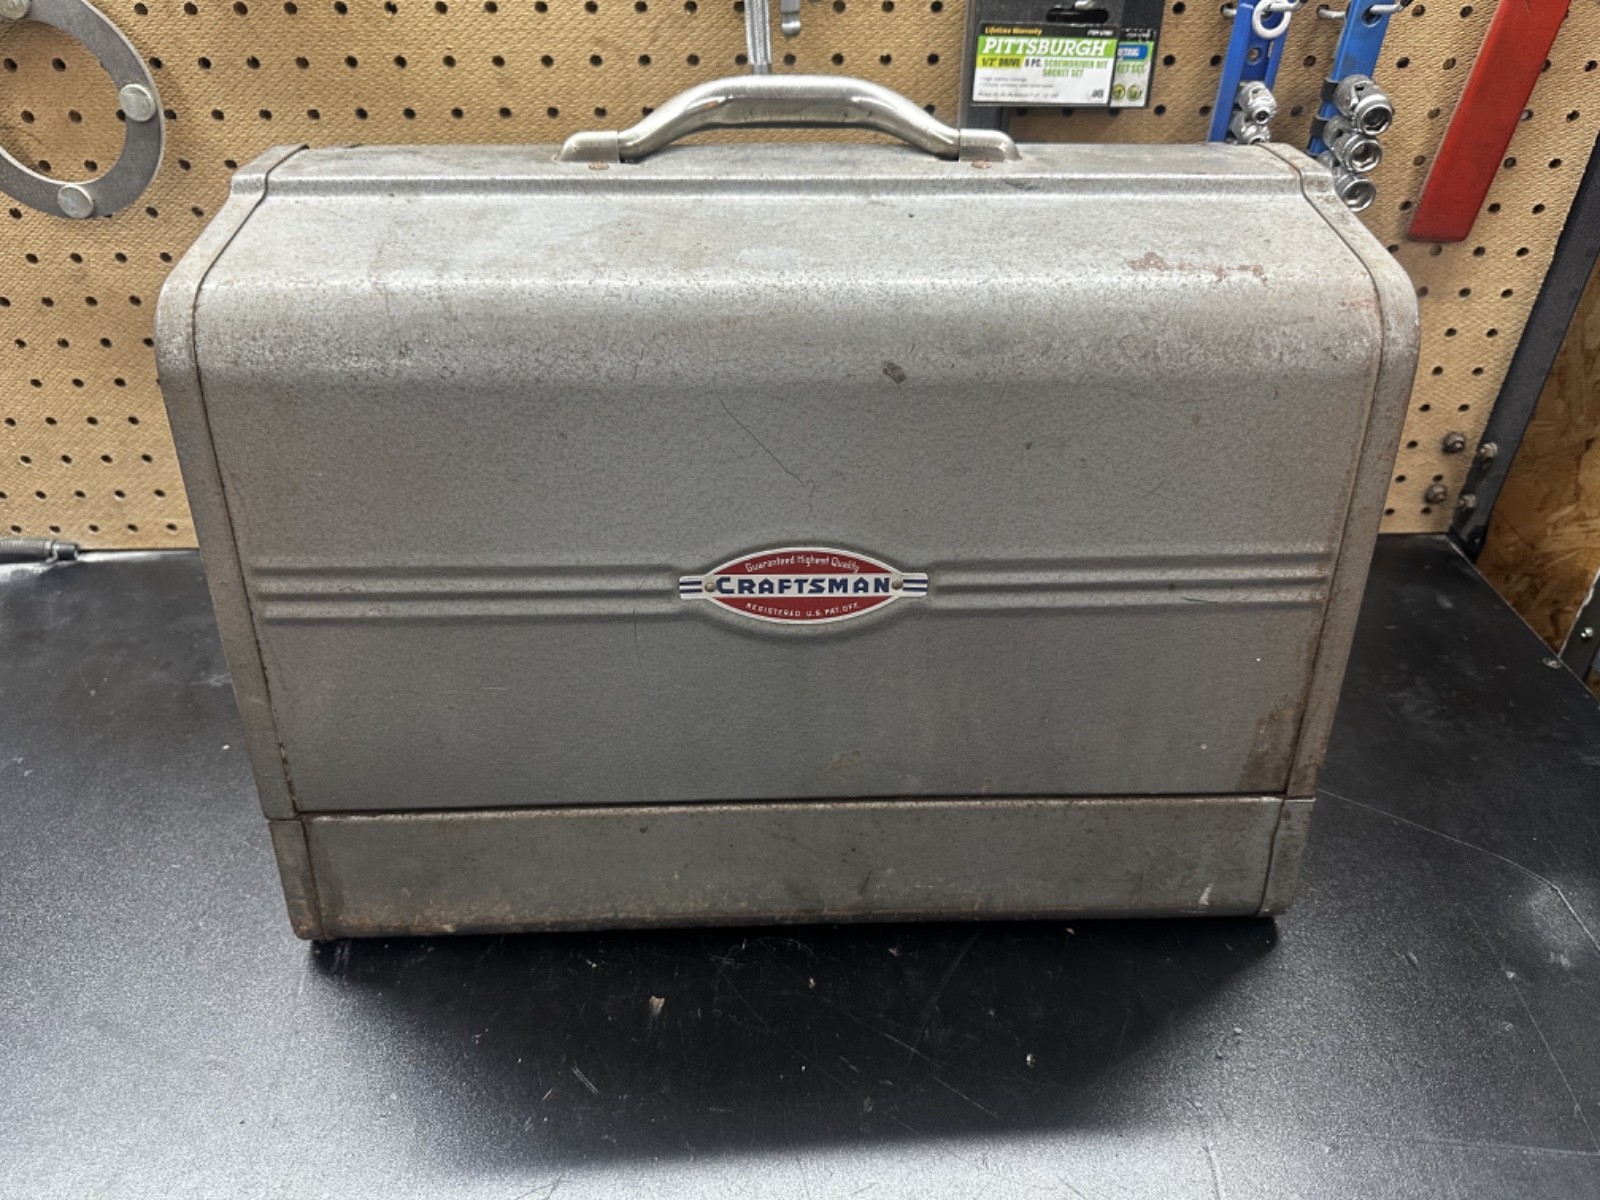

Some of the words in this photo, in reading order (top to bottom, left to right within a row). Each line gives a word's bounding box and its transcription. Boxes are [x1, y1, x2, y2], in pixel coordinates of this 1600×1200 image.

[1012, 28, 1042, 36] Warranty
[982, 39, 1106, 55] PITTSBURGH
[999, 57, 1021, 68] DRIVE
[1043, 69, 1069, 77] SOCKET
[1071, 70, 1084, 78] SET
[745, 556, 795, 572] Guaranteed
[796, 555, 830, 567] Highest
[831, 557, 860, 573] Quality
[716, 577, 890, 594] CRAFTSMAN
[746, 602, 801, 617] REGISTERED
[806, 609, 822, 617] U.S.
